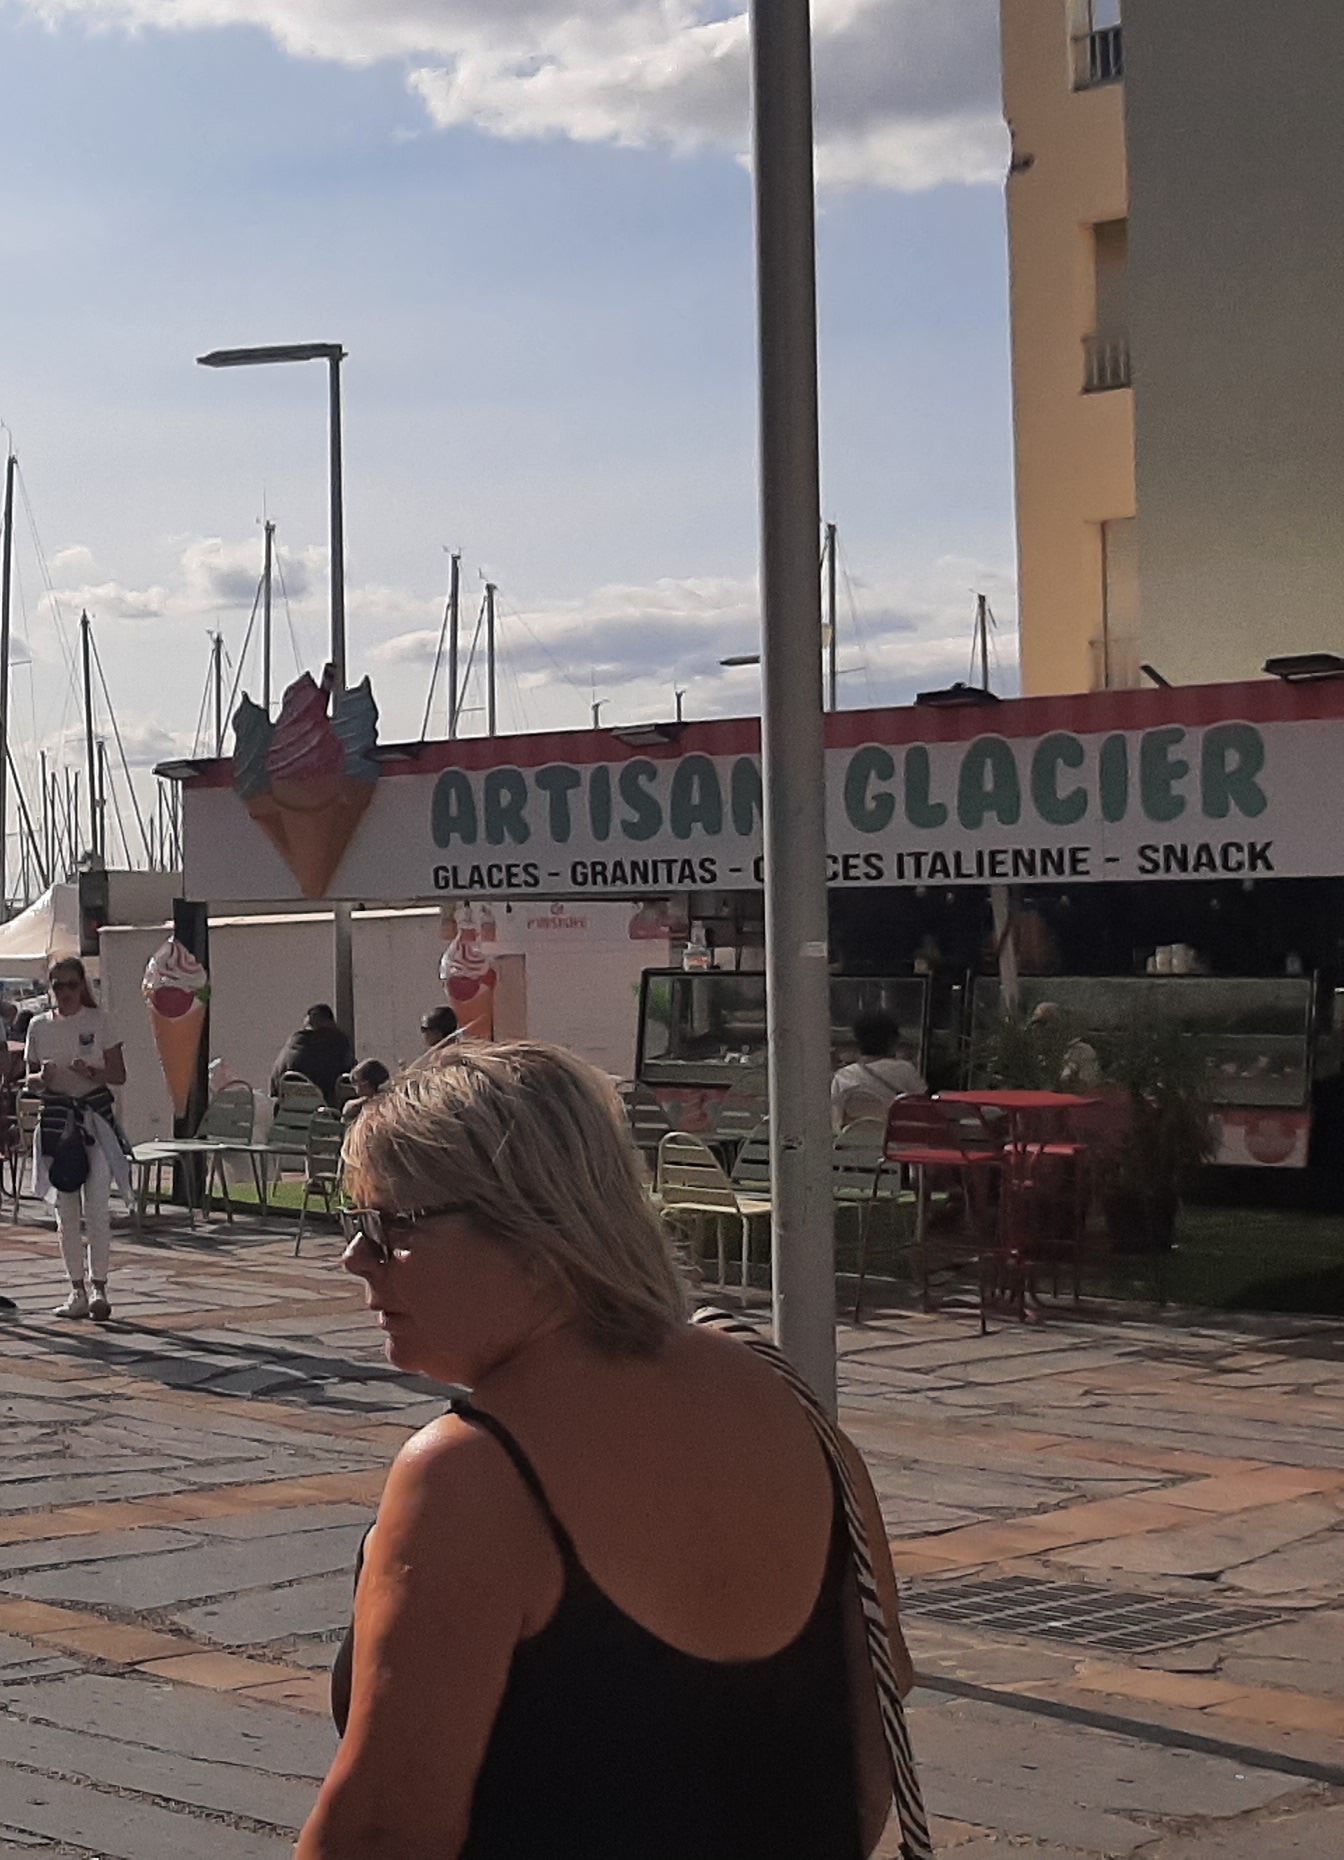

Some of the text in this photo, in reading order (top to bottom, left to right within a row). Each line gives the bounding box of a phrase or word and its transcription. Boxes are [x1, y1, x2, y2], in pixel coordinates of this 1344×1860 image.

[432, 721, 1268, 848] ARTISAN GLACIER
[433, 862, 540, 890] GLACES
[570, 857, 717, 886] GRANITAS
[896, 847, 1091, 880] ITALIENNE
[1137, 840, 1275, 875] SNACK
